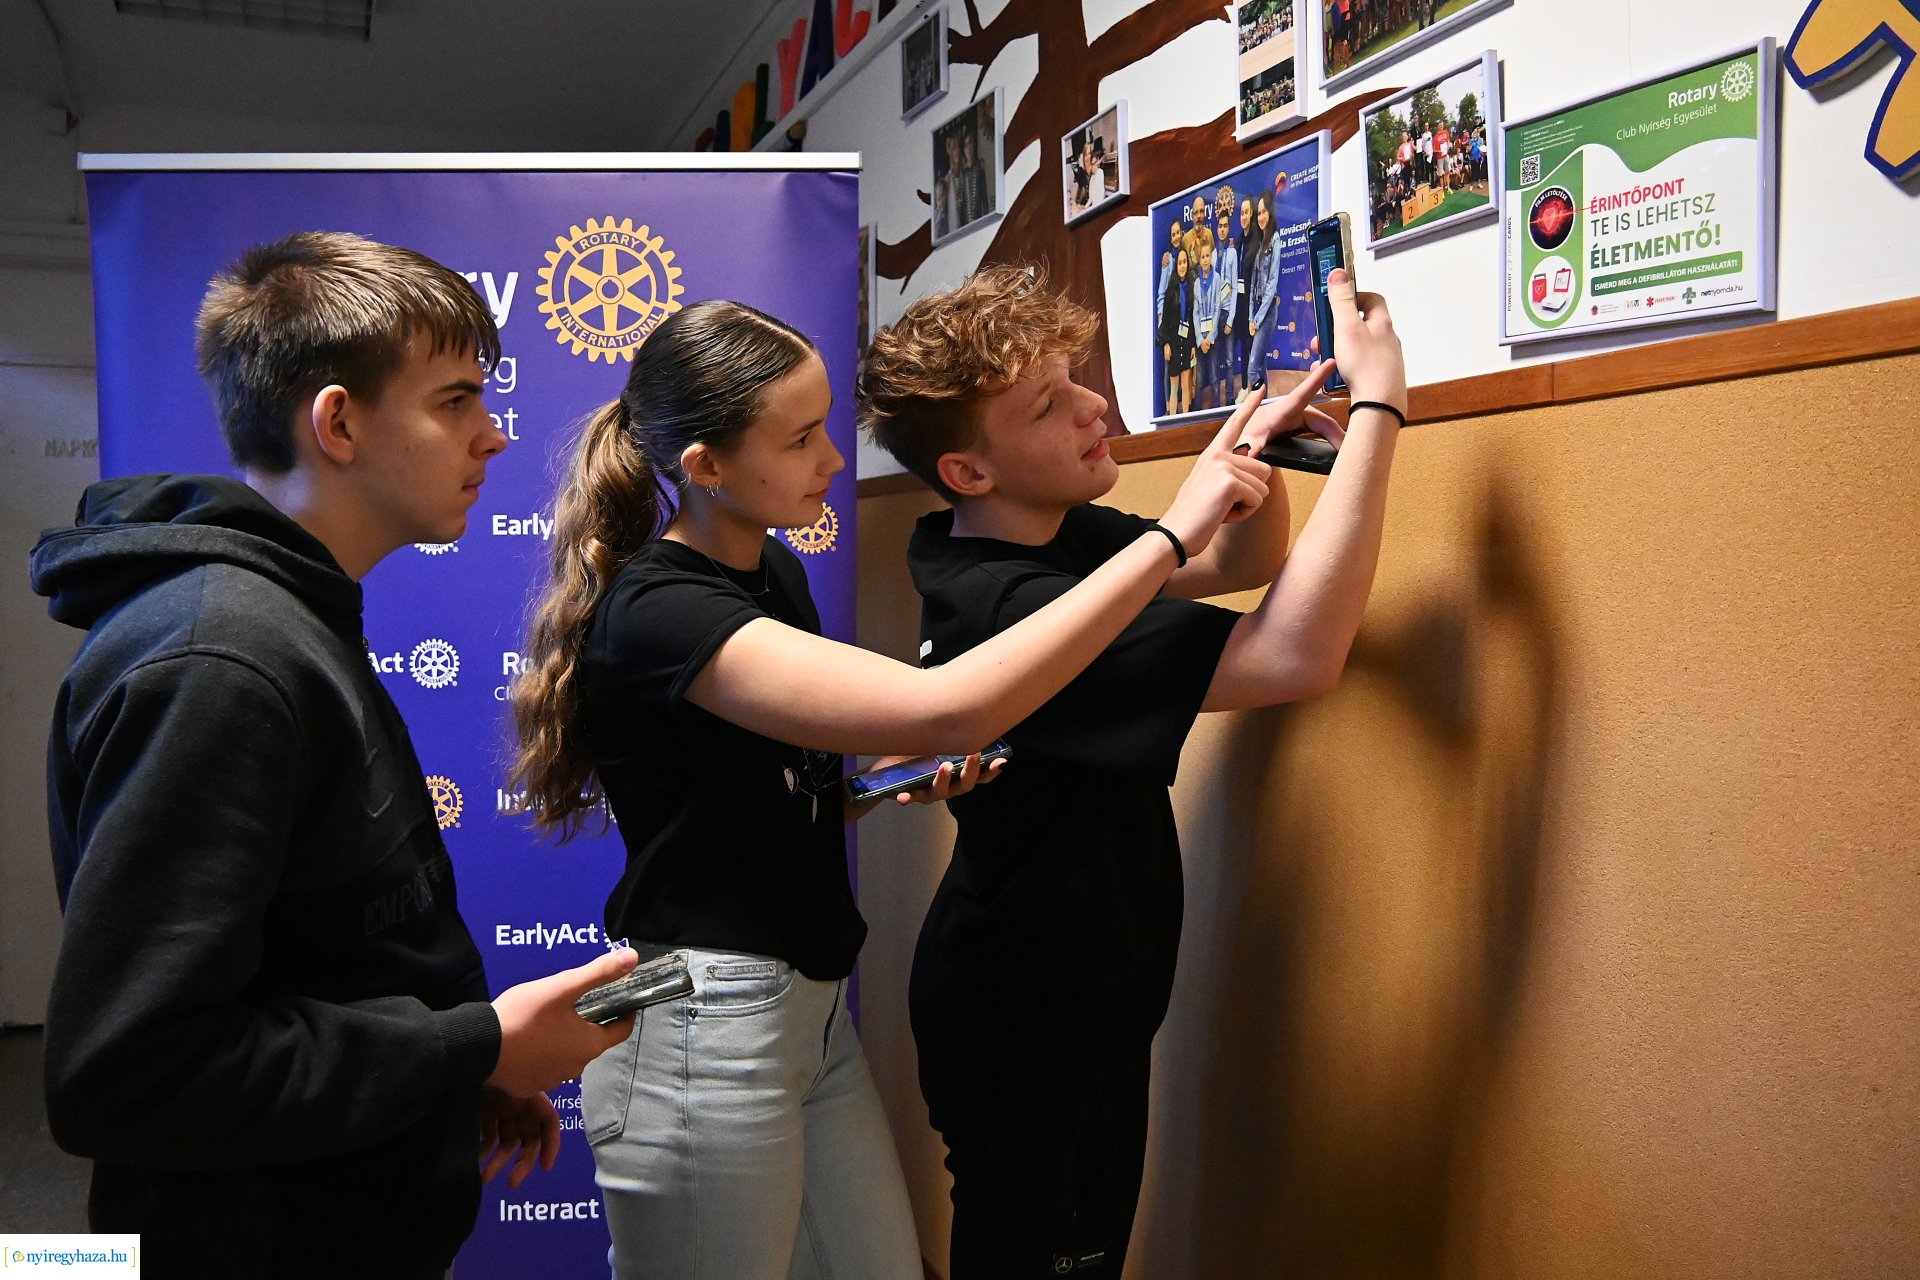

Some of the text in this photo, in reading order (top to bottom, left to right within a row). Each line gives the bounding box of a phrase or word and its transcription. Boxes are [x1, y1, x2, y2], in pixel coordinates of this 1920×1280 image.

[1668, 82, 1718, 109] Rotary
[1616, 103, 1718, 140] Club Nyírség Egyesület
[1303, 172, 1319, 184] WORL
[1308, 164, 1319, 175] HOP
[1534, 196, 1546, 208] FILM
[1590, 178, 1685, 215] ÉRINTŐPONT
[1408, 205, 1414, 220] 2
[1590, 192, 1716, 237] TE IS LEHETSZ
[578, 232, 641, 250] ROTARY
[1287, 234, 1307, 247] Erzsé
[1590, 219, 1721, 270] ÉLETMENTŐ!
[1594, 259, 1738, 291] ISMERD MEG A DEFIBRILLÁTOR HASZNÁLATÁT!
[560, 310, 664, 349] INTERNATIONAL
[44, 438, 99, 459] NAPK
[492, 512, 555, 541] Early
[368, 651, 404, 673] Act
[496, 922, 599, 950] EarlyAct
[500, 1198, 600, 1222] Interact
